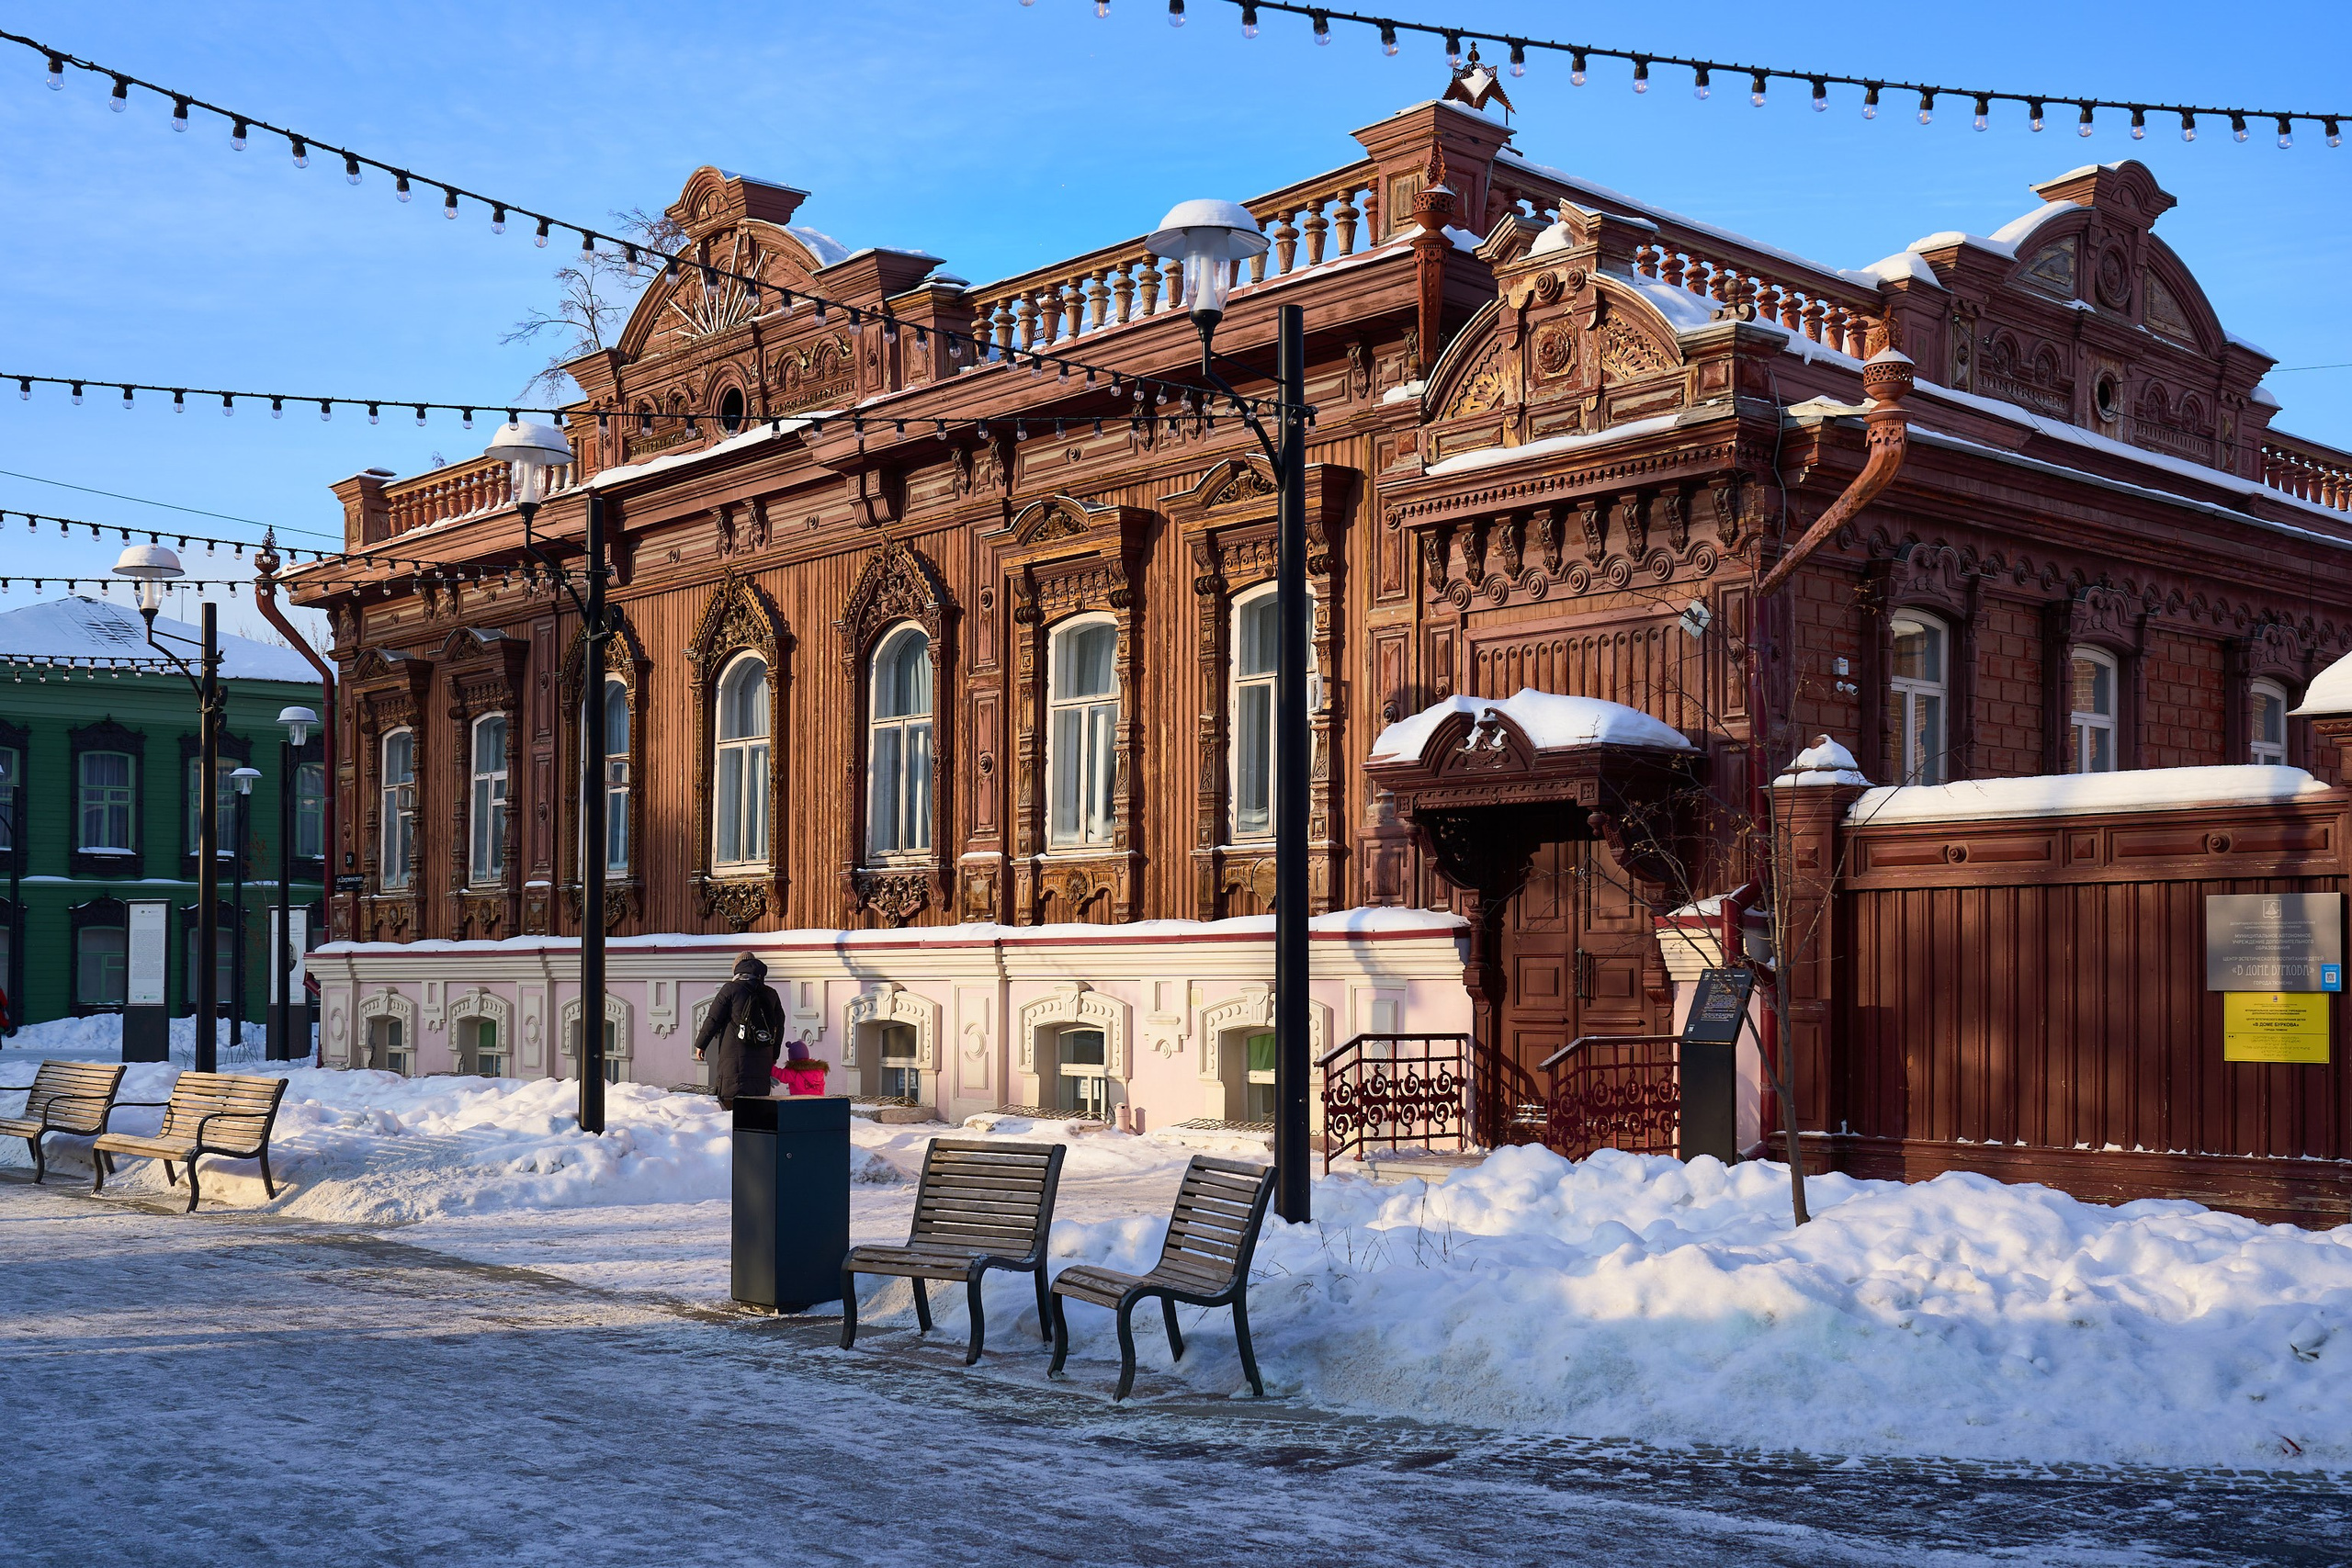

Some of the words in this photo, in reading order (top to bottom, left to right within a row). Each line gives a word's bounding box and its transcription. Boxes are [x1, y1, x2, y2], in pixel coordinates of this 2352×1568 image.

[345, 855, 353, 863] 30
[2245, 964, 2269, 976] ДОМЕ
[2271, 964, 2315, 976] БУРКОВА»
